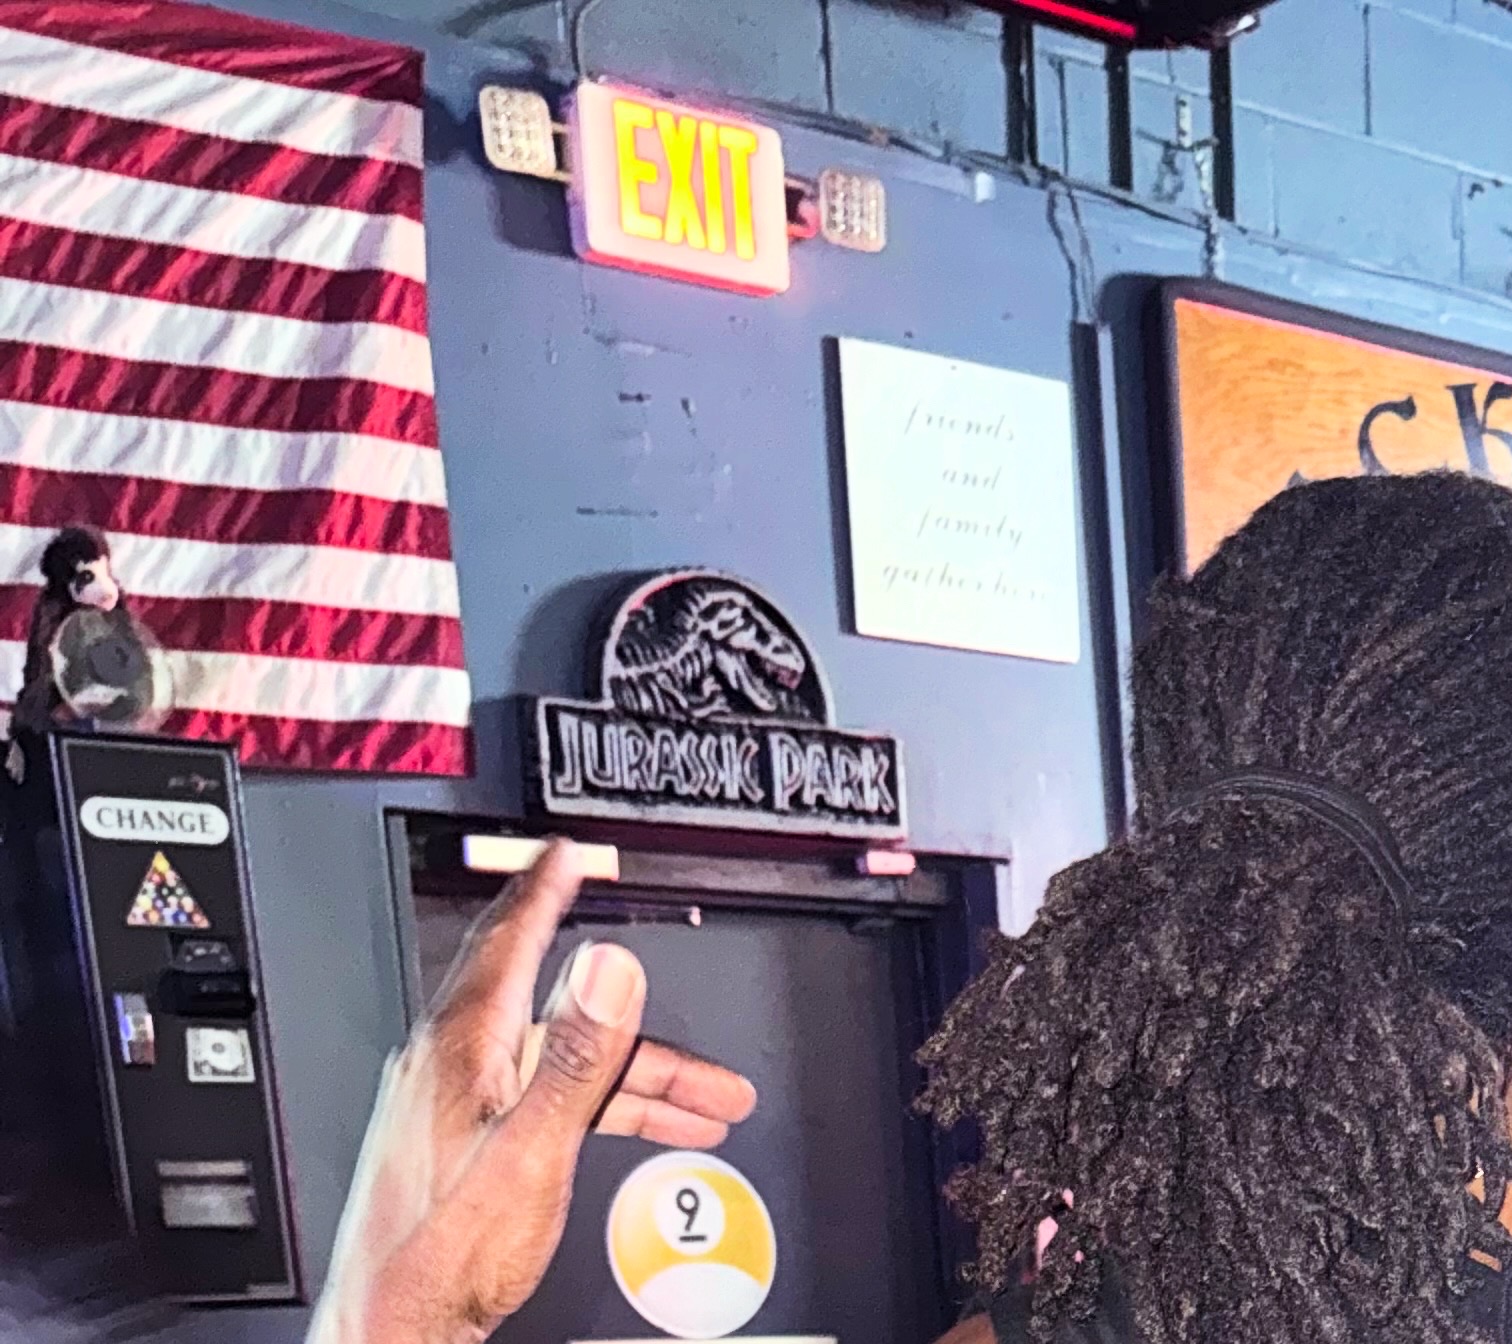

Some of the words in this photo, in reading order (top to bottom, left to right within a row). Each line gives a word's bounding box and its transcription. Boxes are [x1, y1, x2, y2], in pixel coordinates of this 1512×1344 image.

[613, 98, 757, 261] EXIT
[942, 465, 1002, 491] and
[556, 711, 764, 802] JURASSIC
[768, 732, 894, 814] PARK
[96, 807, 217, 834] CHANGE
[676, 1187, 702, 1236] 9
